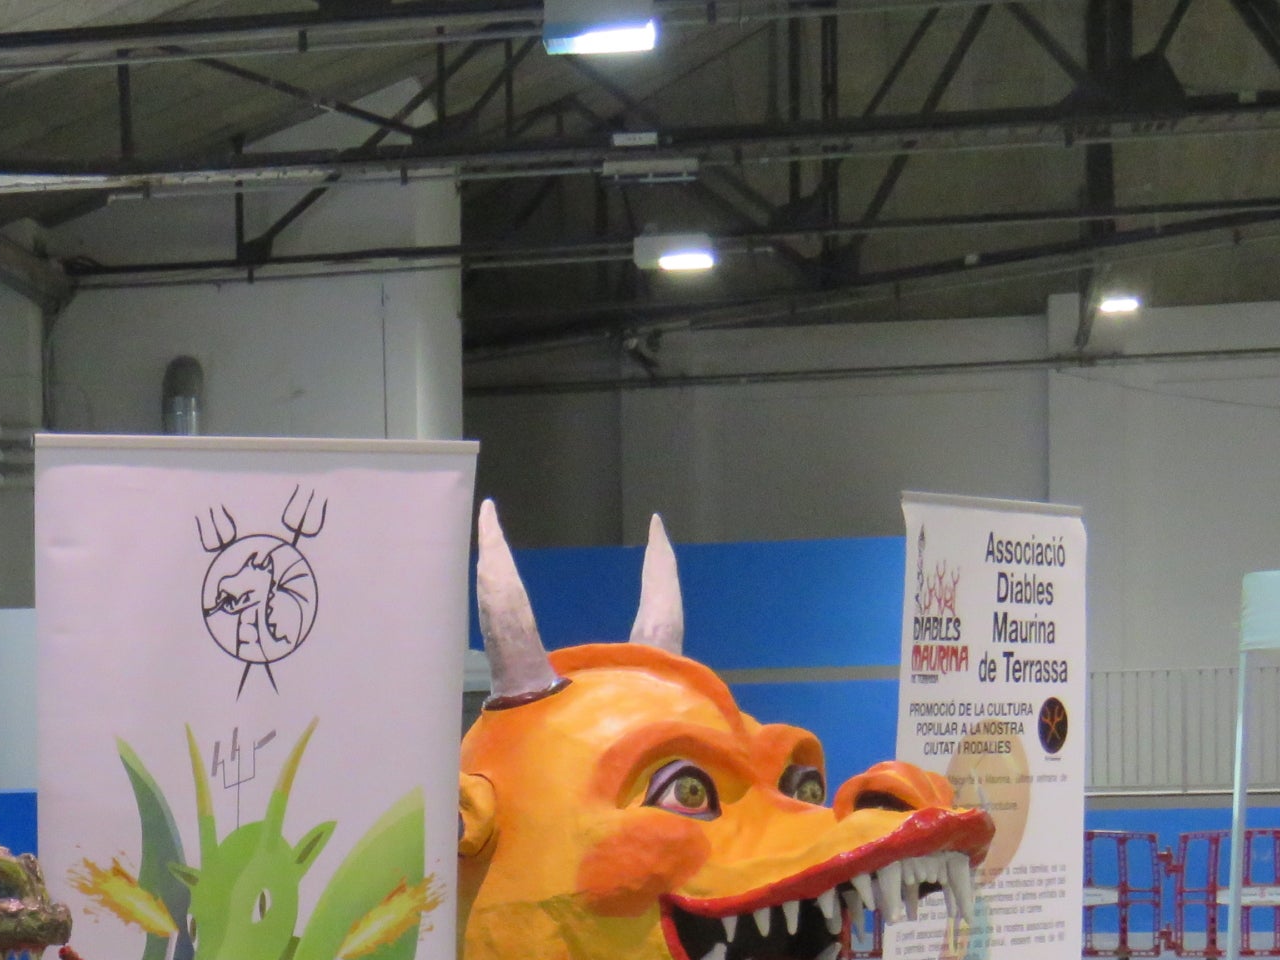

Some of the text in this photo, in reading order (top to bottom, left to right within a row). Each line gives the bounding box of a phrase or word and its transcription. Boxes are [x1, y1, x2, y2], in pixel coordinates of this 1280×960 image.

[985, 532, 1066, 567] Associació
[997, 572, 1054, 605] Diables
[914, 616, 961, 641] DIABLES
[992, 612, 1055, 644] Maurina
[912, 644, 968, 674] MAURINA
[978, 651, 1068, 683] de Terrassa
[910, 700, 1033, 716] PROMOCIÓ DE LA CULTURA
[916, 722, 1024, 736] POPULAR A LA NOSTRA
[924, 741, 955, 755] CIUTAT
[964, 741, 1011, 754] RODALIES
